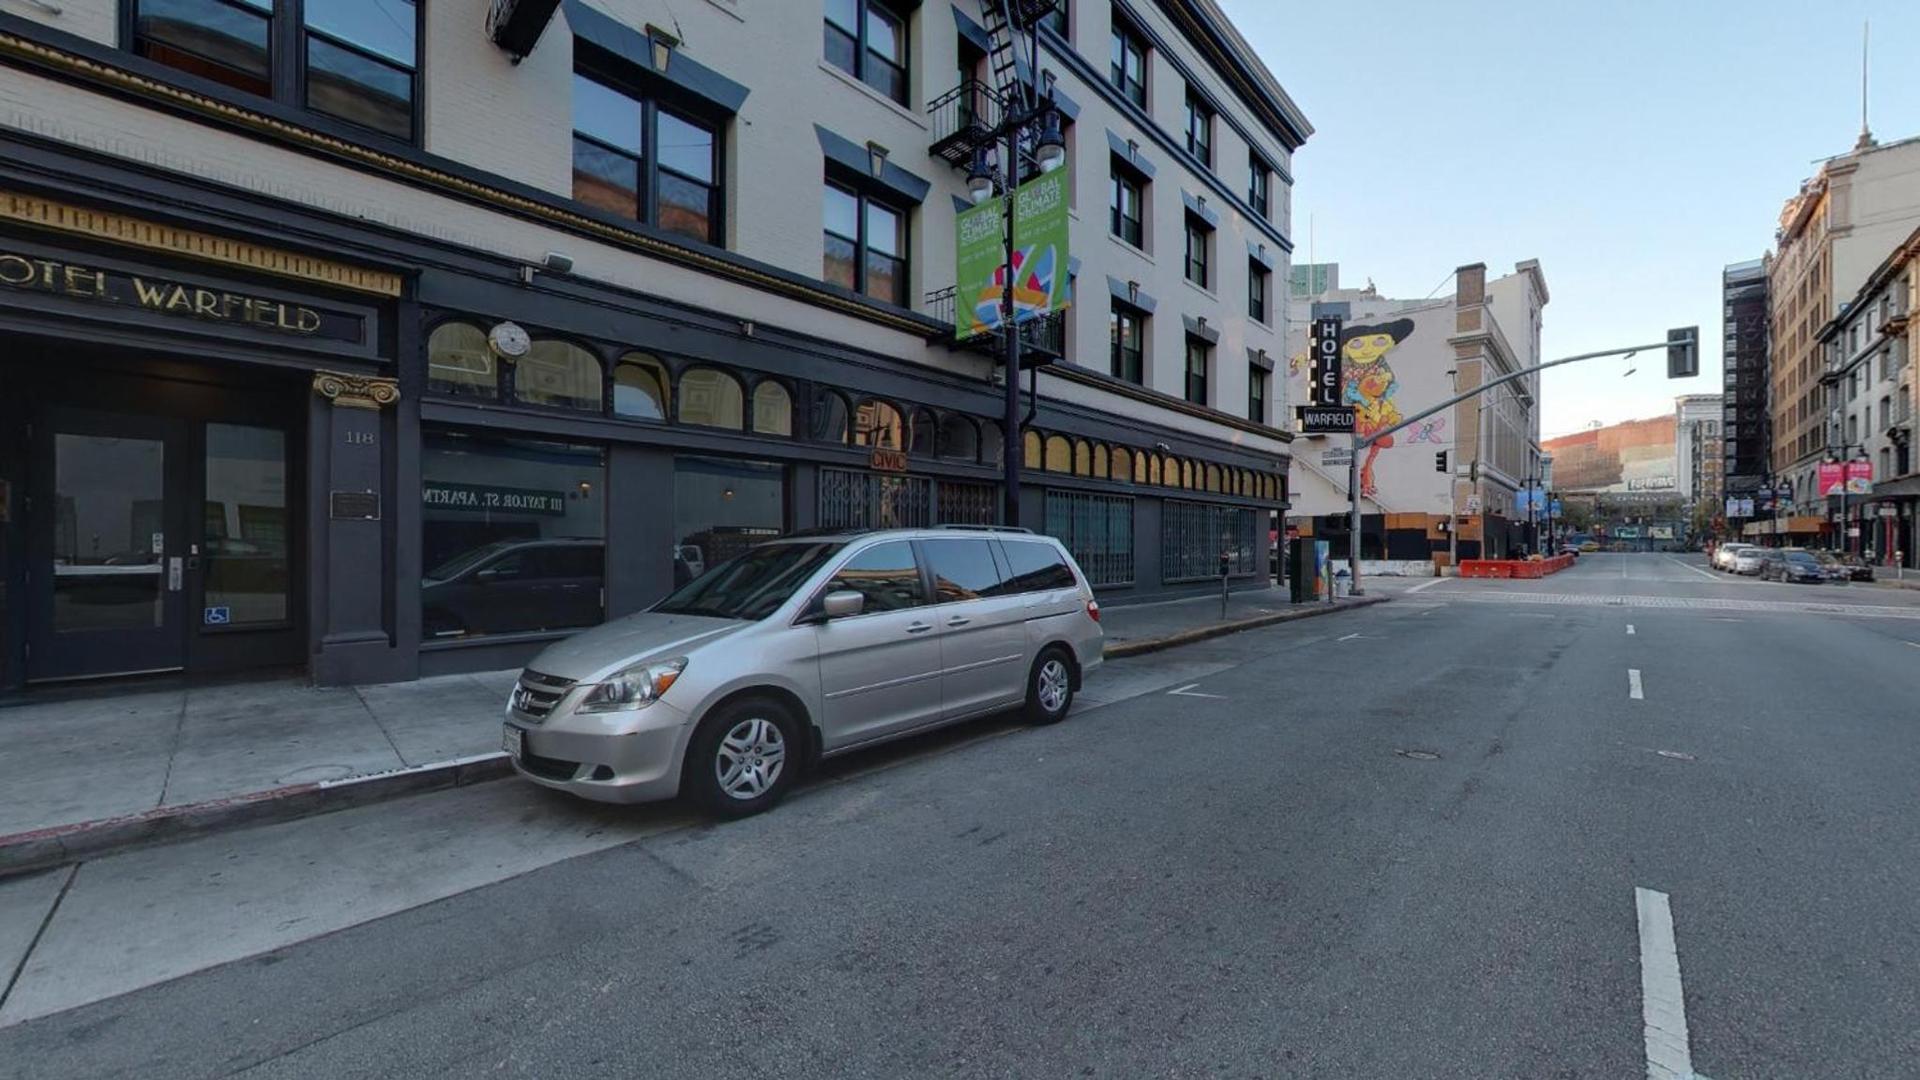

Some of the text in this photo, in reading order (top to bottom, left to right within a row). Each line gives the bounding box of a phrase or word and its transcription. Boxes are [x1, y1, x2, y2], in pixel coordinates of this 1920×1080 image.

[133, 277, 321, 332] WARFIELD
[1321, 323, 1337, 403] HOTEL
[1304, 413, 1354, 426] WARFIELD
[344, 431, 374, 444] 118
